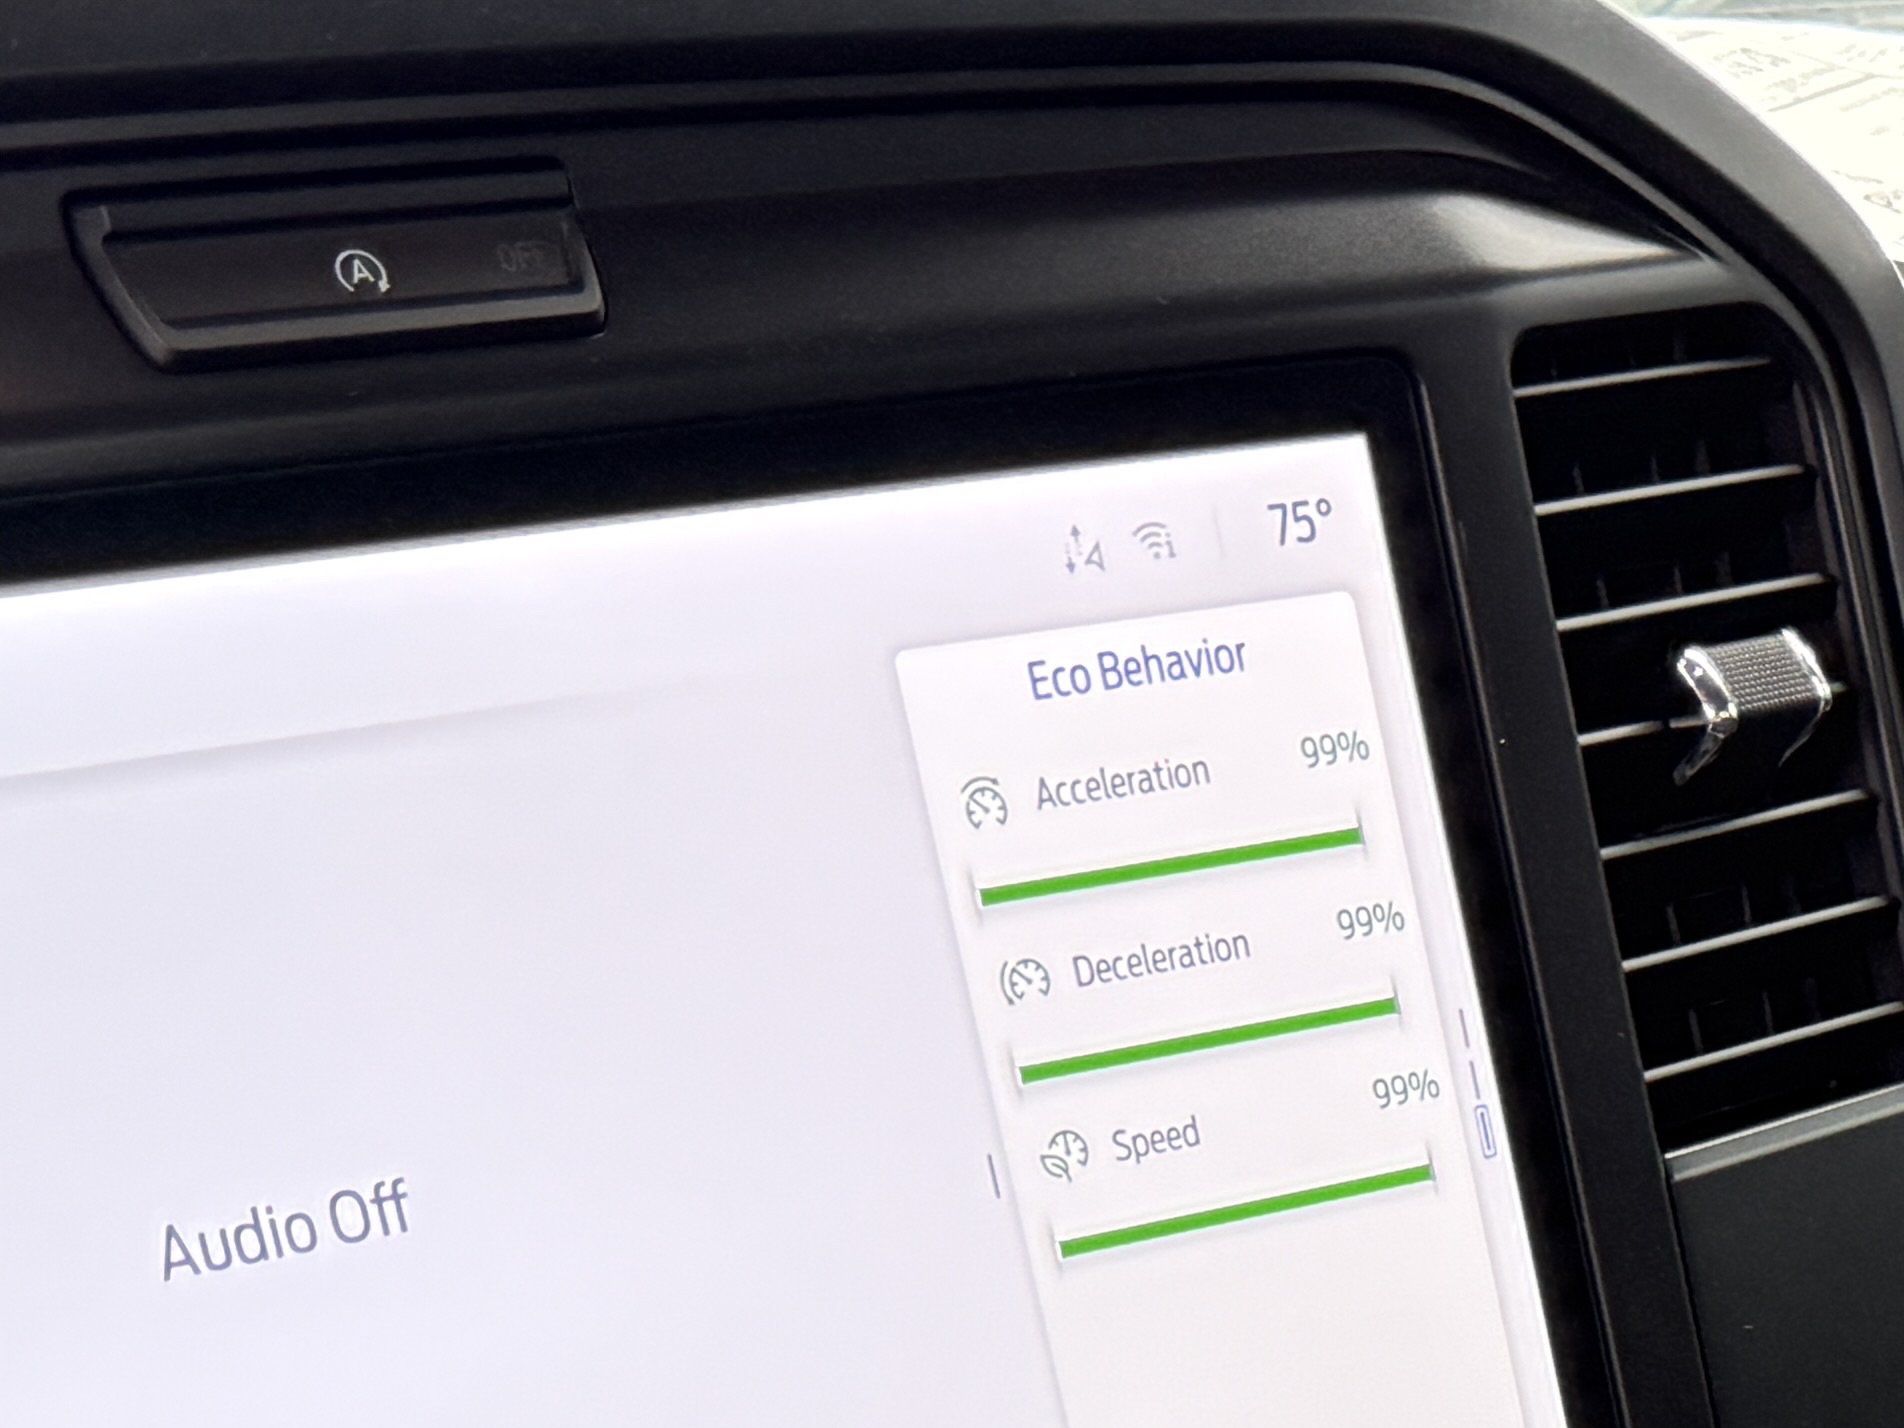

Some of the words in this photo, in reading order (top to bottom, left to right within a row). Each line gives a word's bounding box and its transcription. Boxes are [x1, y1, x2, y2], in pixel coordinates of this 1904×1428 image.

[1266, 498, 1333, 549] 75°
[1026, 656, 1092, 702] Eco
[1097, 637, 1248, 691] Behavior
[1034, 754, 1213, 813] Acceleration
[1300, 729, 1372, 771] 99%
[1071, 929, 1253, 990] Deceleration
[1336, 899, 1407, 942] 99%
[1112, 1114, 1203, 1167] Speed
[1371, 1069, 1442, 1111] 99%
[162, 1205, 319, 1283] Audio
[328, 1176, 410, 1245] Off
